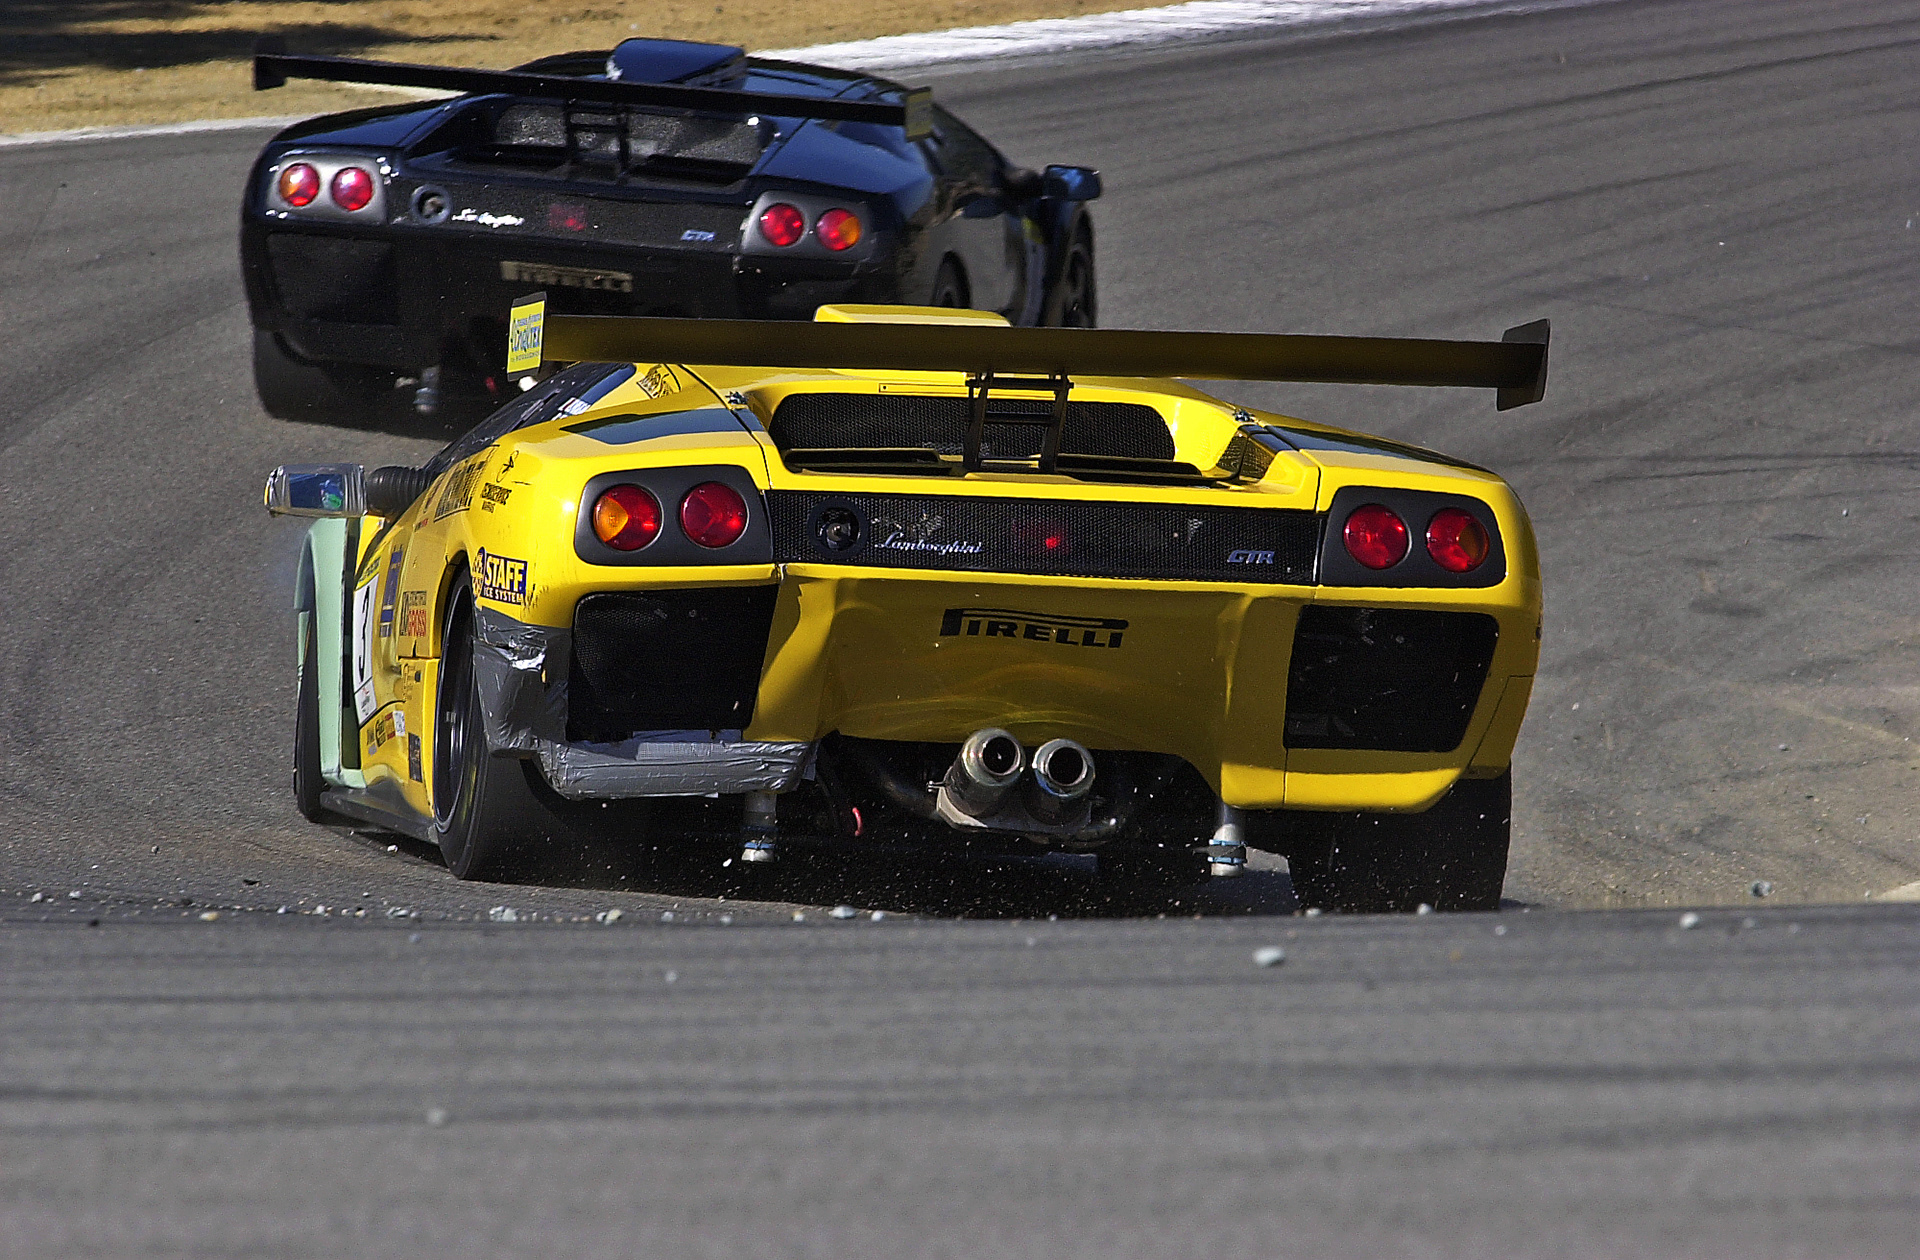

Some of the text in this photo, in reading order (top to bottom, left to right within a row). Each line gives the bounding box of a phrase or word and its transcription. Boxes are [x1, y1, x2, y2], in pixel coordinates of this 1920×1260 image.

[874, 531, 984, 556] Lamborghini
[1227, 549, 1275, 565] GTR
[485, 555, 524, 592] STAFF
[939, 608, 1129, 649] PIRELLI
